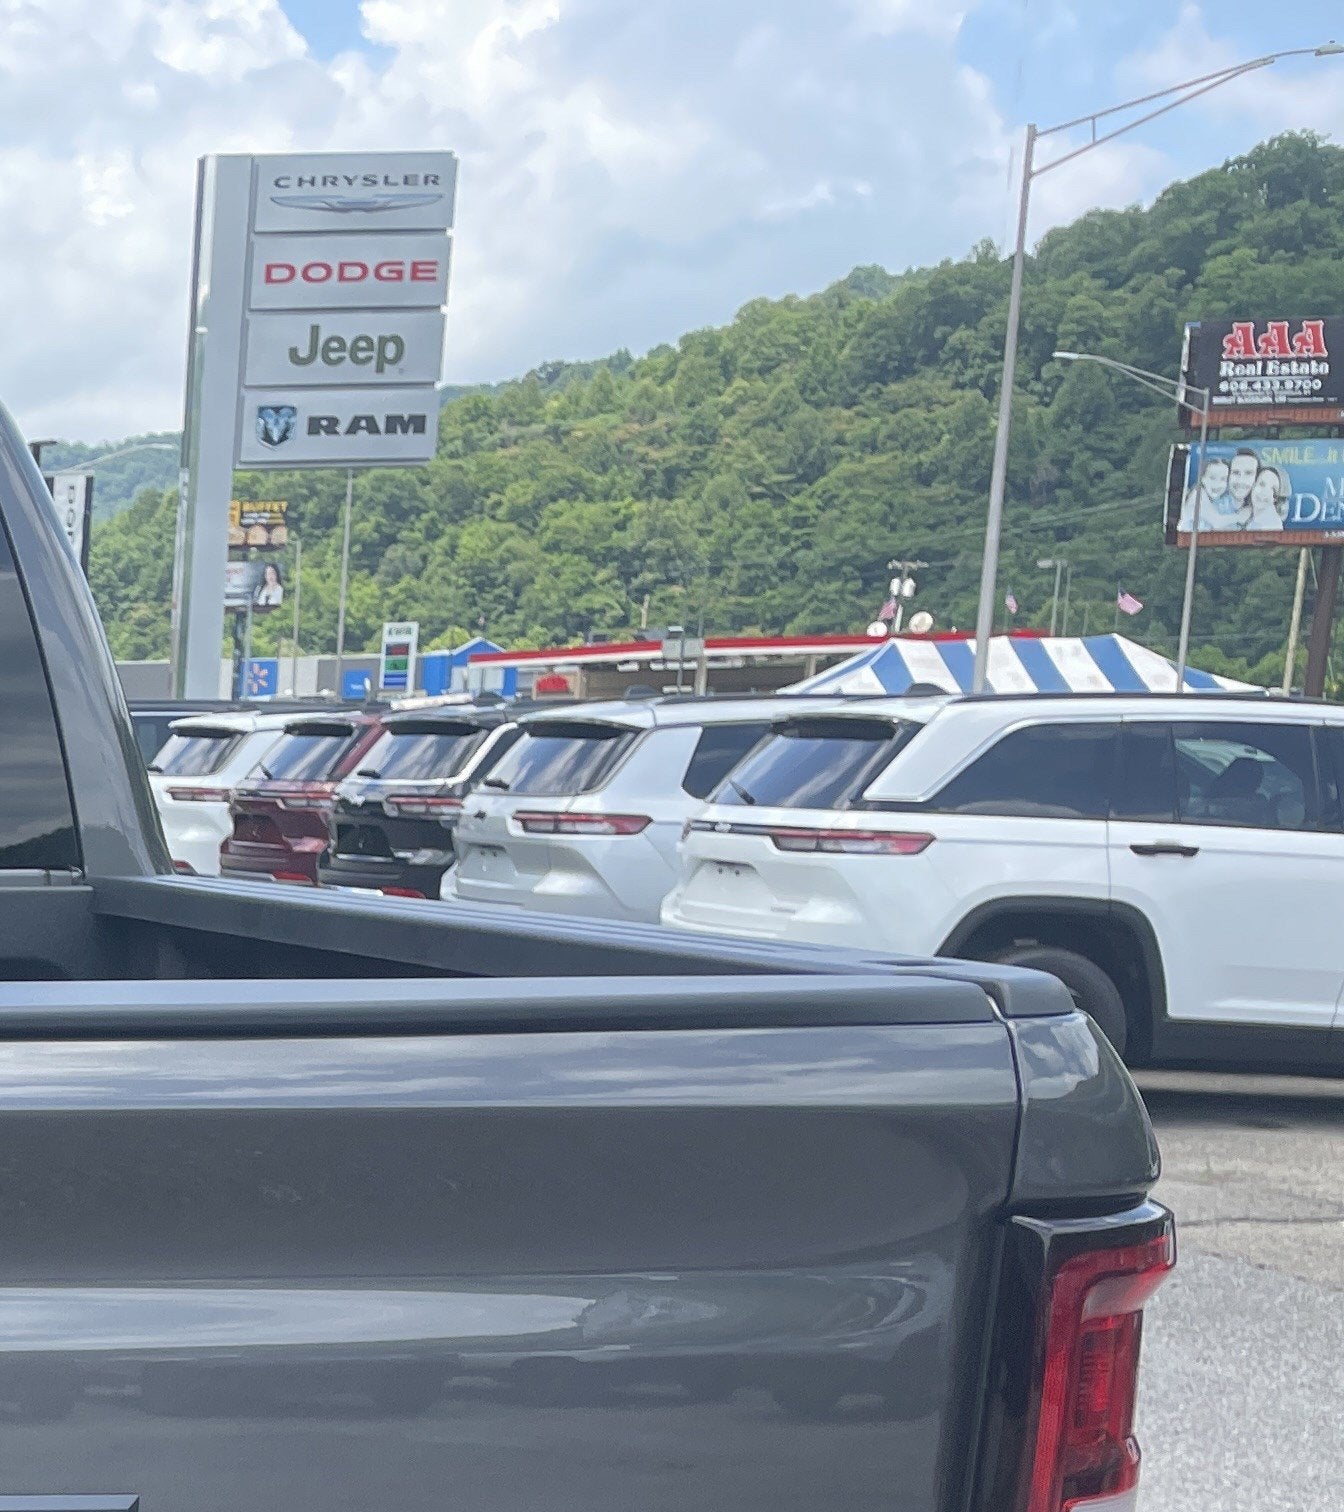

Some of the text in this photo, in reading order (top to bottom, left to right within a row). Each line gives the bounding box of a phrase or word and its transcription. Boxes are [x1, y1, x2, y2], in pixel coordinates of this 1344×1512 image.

[273, 173, 441, 189] CHRYSLER
[264, 260, 439, 286] DODGE
[288, 323, 405, 373] Jeep
[1222, 320, 1329, 359] AAA
[307, 414, 427, 436] RAM
